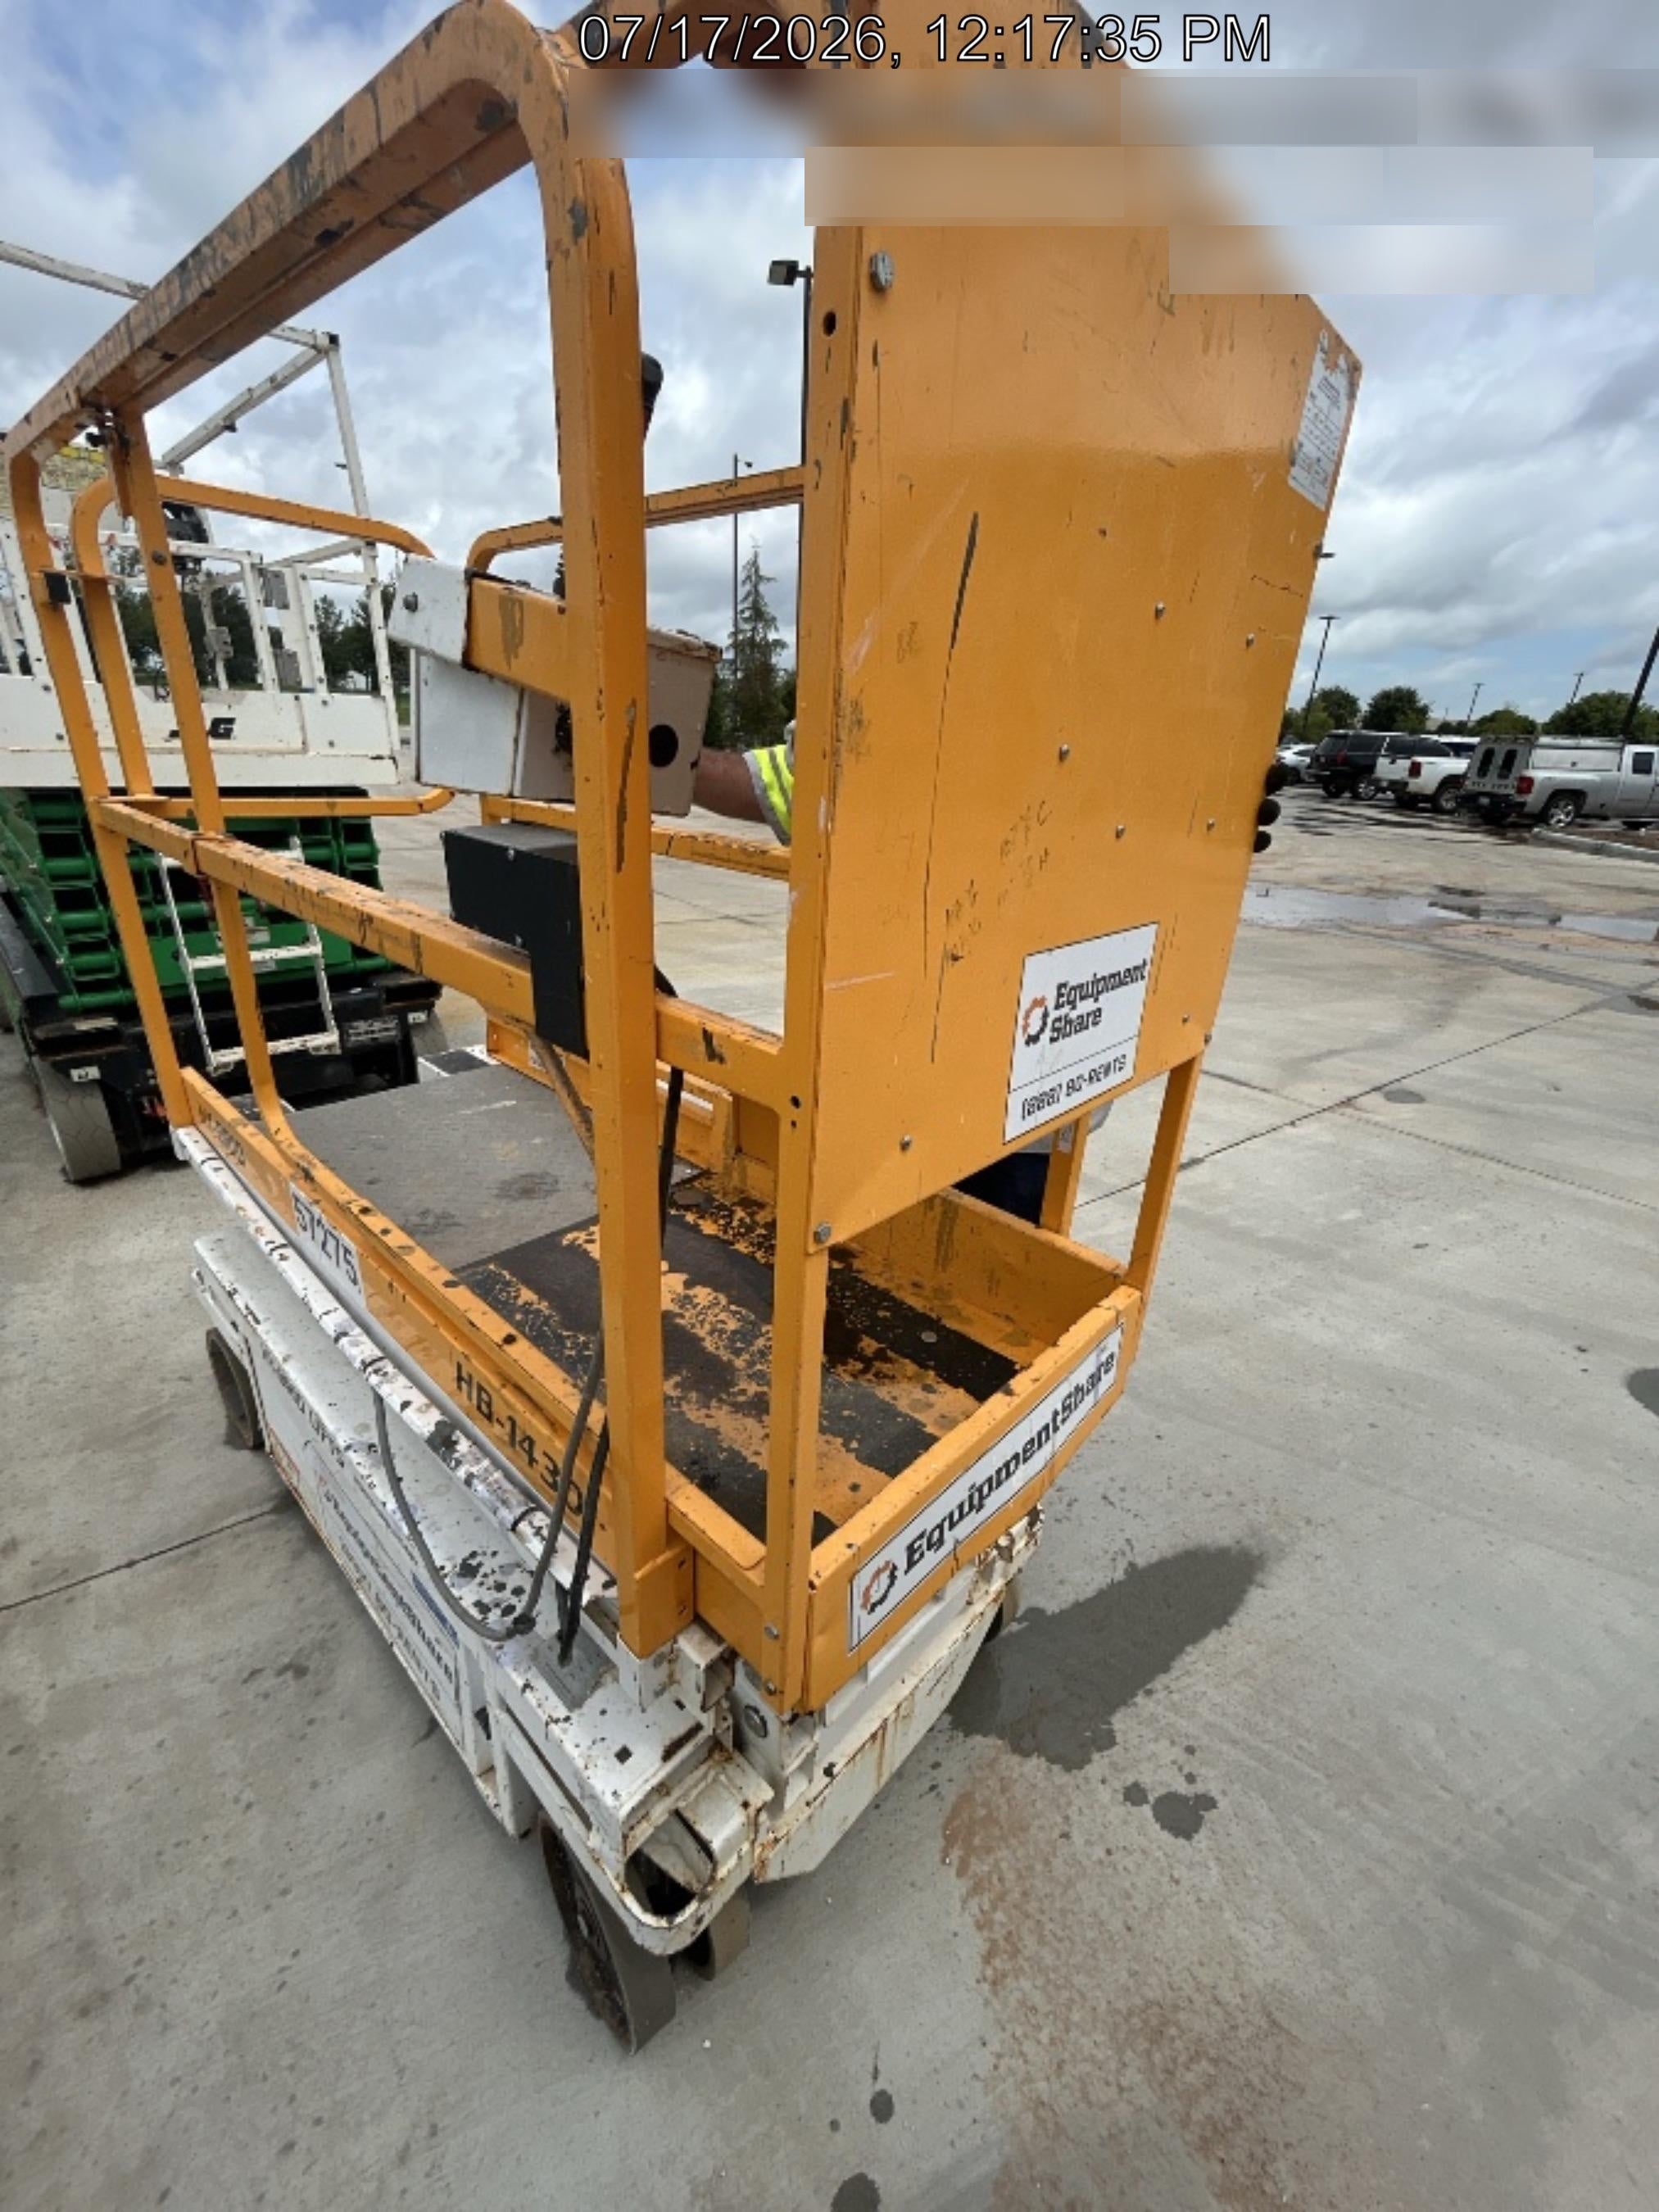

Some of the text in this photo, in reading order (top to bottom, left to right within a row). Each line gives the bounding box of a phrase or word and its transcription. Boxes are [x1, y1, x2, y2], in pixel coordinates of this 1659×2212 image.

[1049, 1007, 1102, 1045] Share
[1054, 958, 1147, 1011] Equipment
[456, 1361, 582, 1515] HB-1430
[904, 1352, 1115, 1575] EquipmentShare
